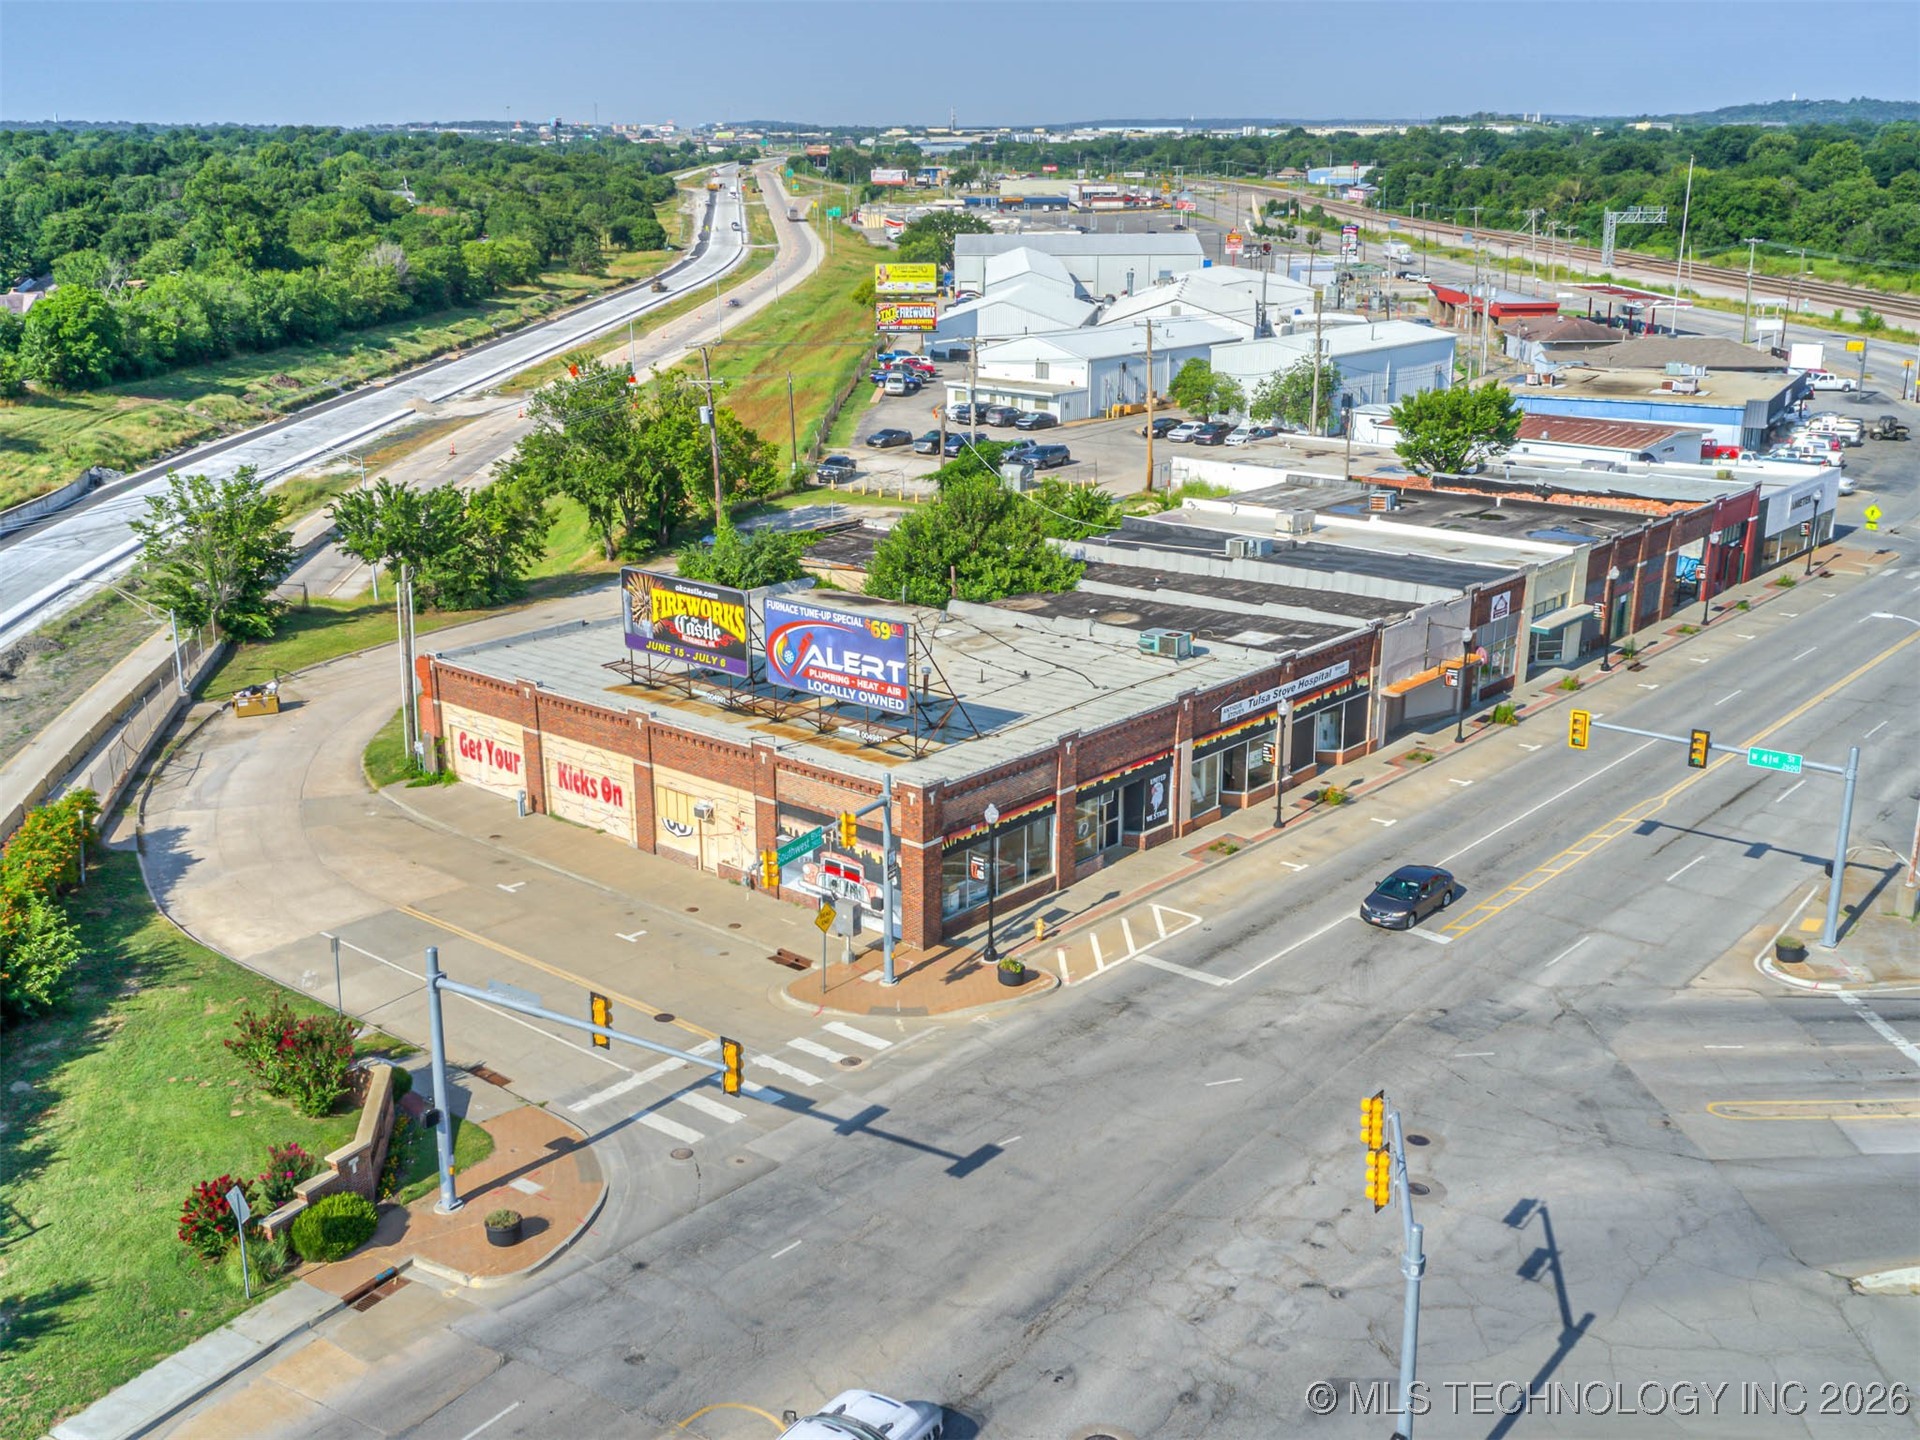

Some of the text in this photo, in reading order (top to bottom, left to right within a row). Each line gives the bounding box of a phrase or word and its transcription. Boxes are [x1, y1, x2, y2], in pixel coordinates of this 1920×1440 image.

[880, 307, 896, 319] TNT
[900, 306, 935, 318] FIREWORKS
[675, 585, 718, 599] okcastle.com
[651, 587, 746, 644] FIREWORKS
[767, 600, 799, 615] FURNACE
[799, 607, 832, 621] TUNE-UP
[832, 612, 864, 627] SPECIAL
[674, 614, 721, 641] Castle
[646, 641, 671, 654] JUNE
[674, 647, 685, 658] 15
[692, 652, 718, 665] JULY
[796, 644, 905, 684] ALERT
[807, 679, 905, 710] LOCALLY OWNED
[809, 669, 850, 685] PLUMBING
[857, 680, 879, 691] HEAT
[886, 688, 901, 696] AIR
[1248, 694, 1270, 708] Tulsa
[1273, 684, 1296, 700] Stove
[1298, 669, 1332, 690] Hospital
[1223, 703, 1243, 714] ANTIQUE
[459, 731, 521, 774] Get Your
[557, 761, 623, 807] Kicks On
[1150, 773, 1166, 785] UNITED
[778, 838, 810, 865] Southwest
